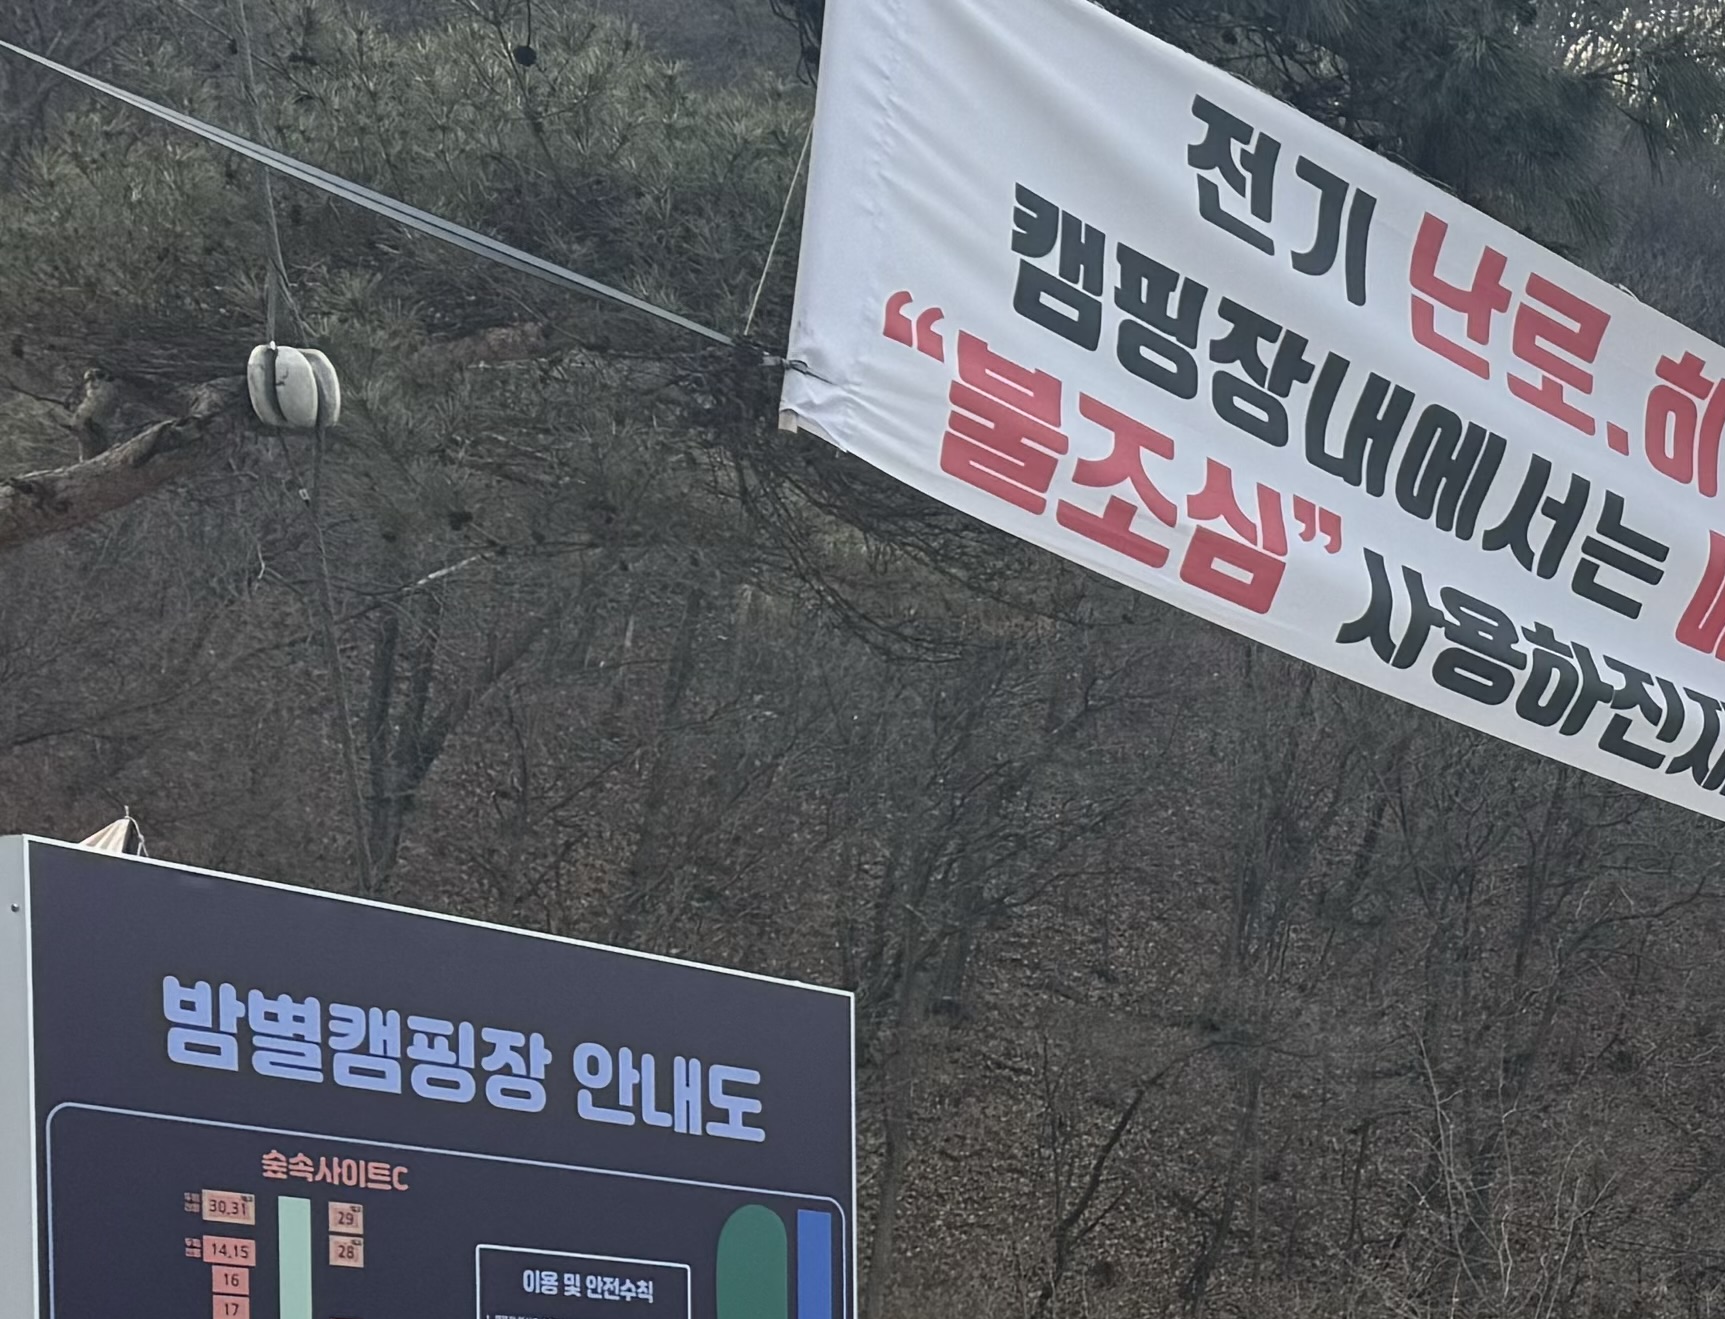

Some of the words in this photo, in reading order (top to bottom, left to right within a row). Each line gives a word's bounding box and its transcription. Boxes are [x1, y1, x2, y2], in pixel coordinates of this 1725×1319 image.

[1186, 93, 1376, 308] 전기
[1011, 182, 1669, 620] 캠핑장내에서는
[162, 975, 552, 1114] 밤별캠핑장
[573, 1041, 765, 1142] 안내도
[261, 1150, 409, 1191] 숲속사이트C
[338, 1211, 354, 1225] 29
[338, 1245, 355, 1259] 28
[224, 1273, 239, 1287] 16
[523, 1269, 559, 1295] 이용
[564, 1273, 581, 1297] 및
[586, 1274, 654, 1304] 안전수칙
[224, 1303, 239, 1316] 17
